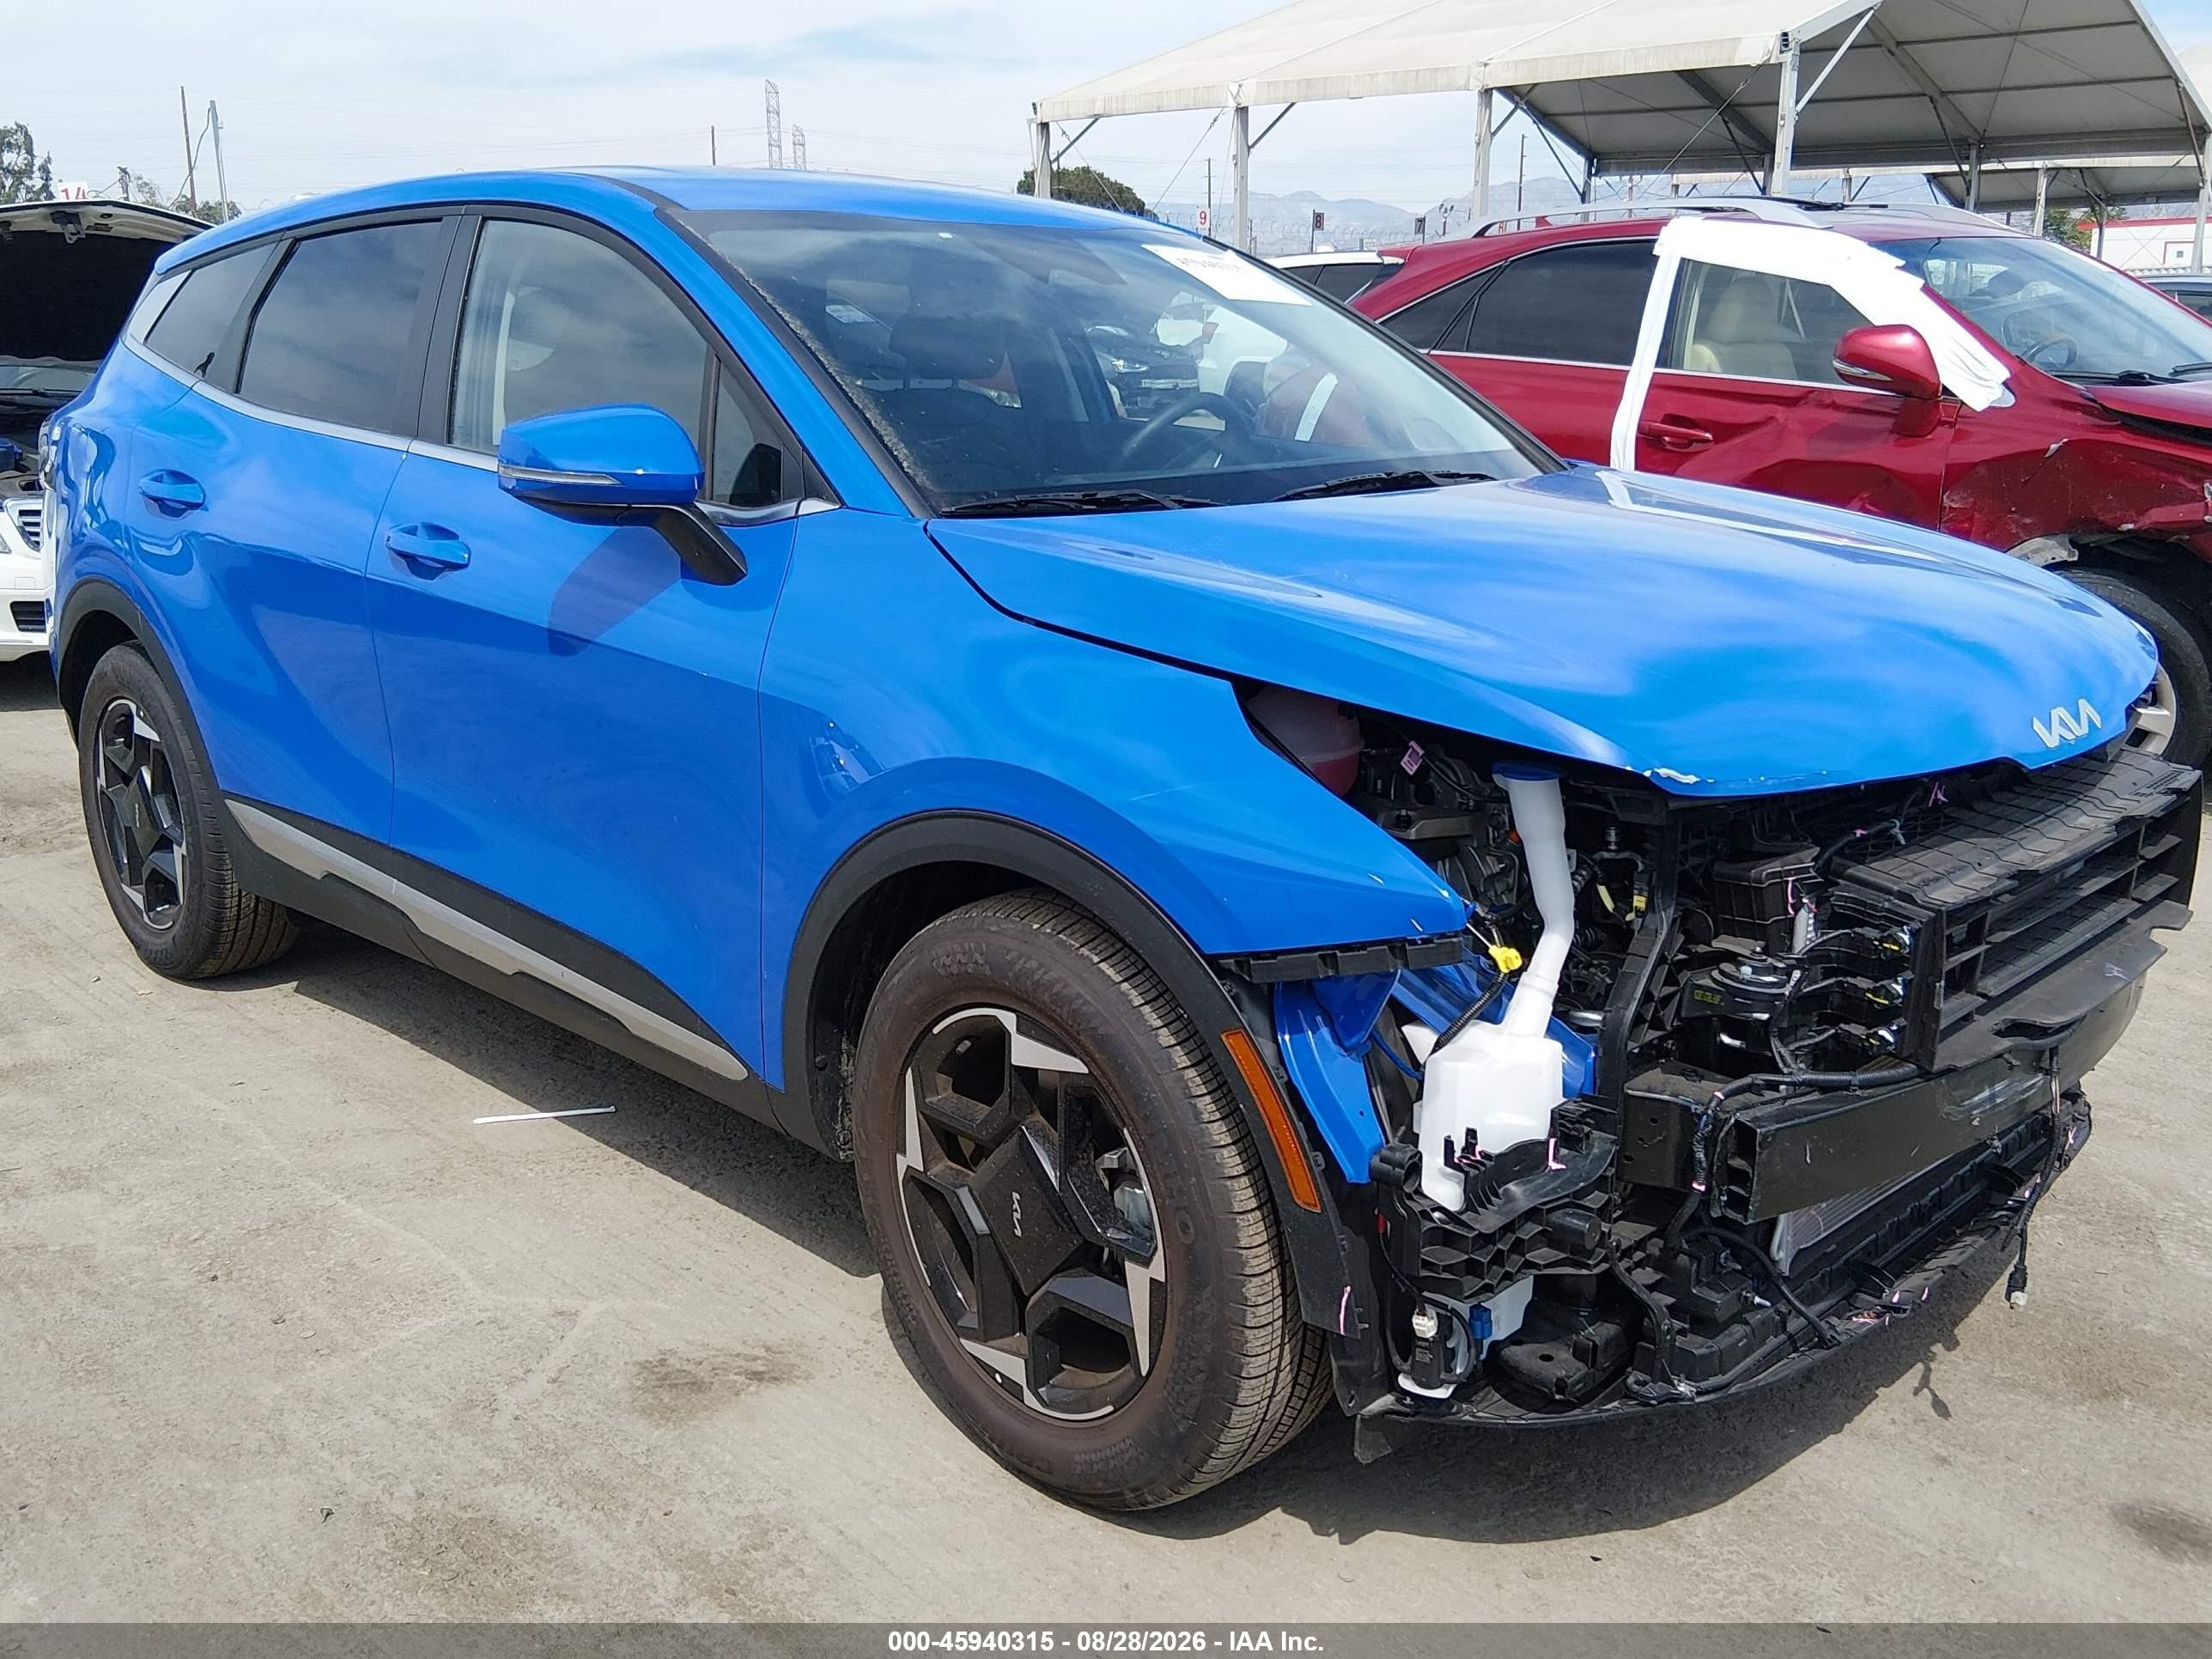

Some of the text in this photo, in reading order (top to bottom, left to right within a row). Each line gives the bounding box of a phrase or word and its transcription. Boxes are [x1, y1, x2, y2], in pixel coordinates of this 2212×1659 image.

[60, 186, 88, 201] 14
[1199, 210, 1207, 225] 9
[1315, 214, 1322, 228] 8
[1417, 219, 1424, 234] 7
